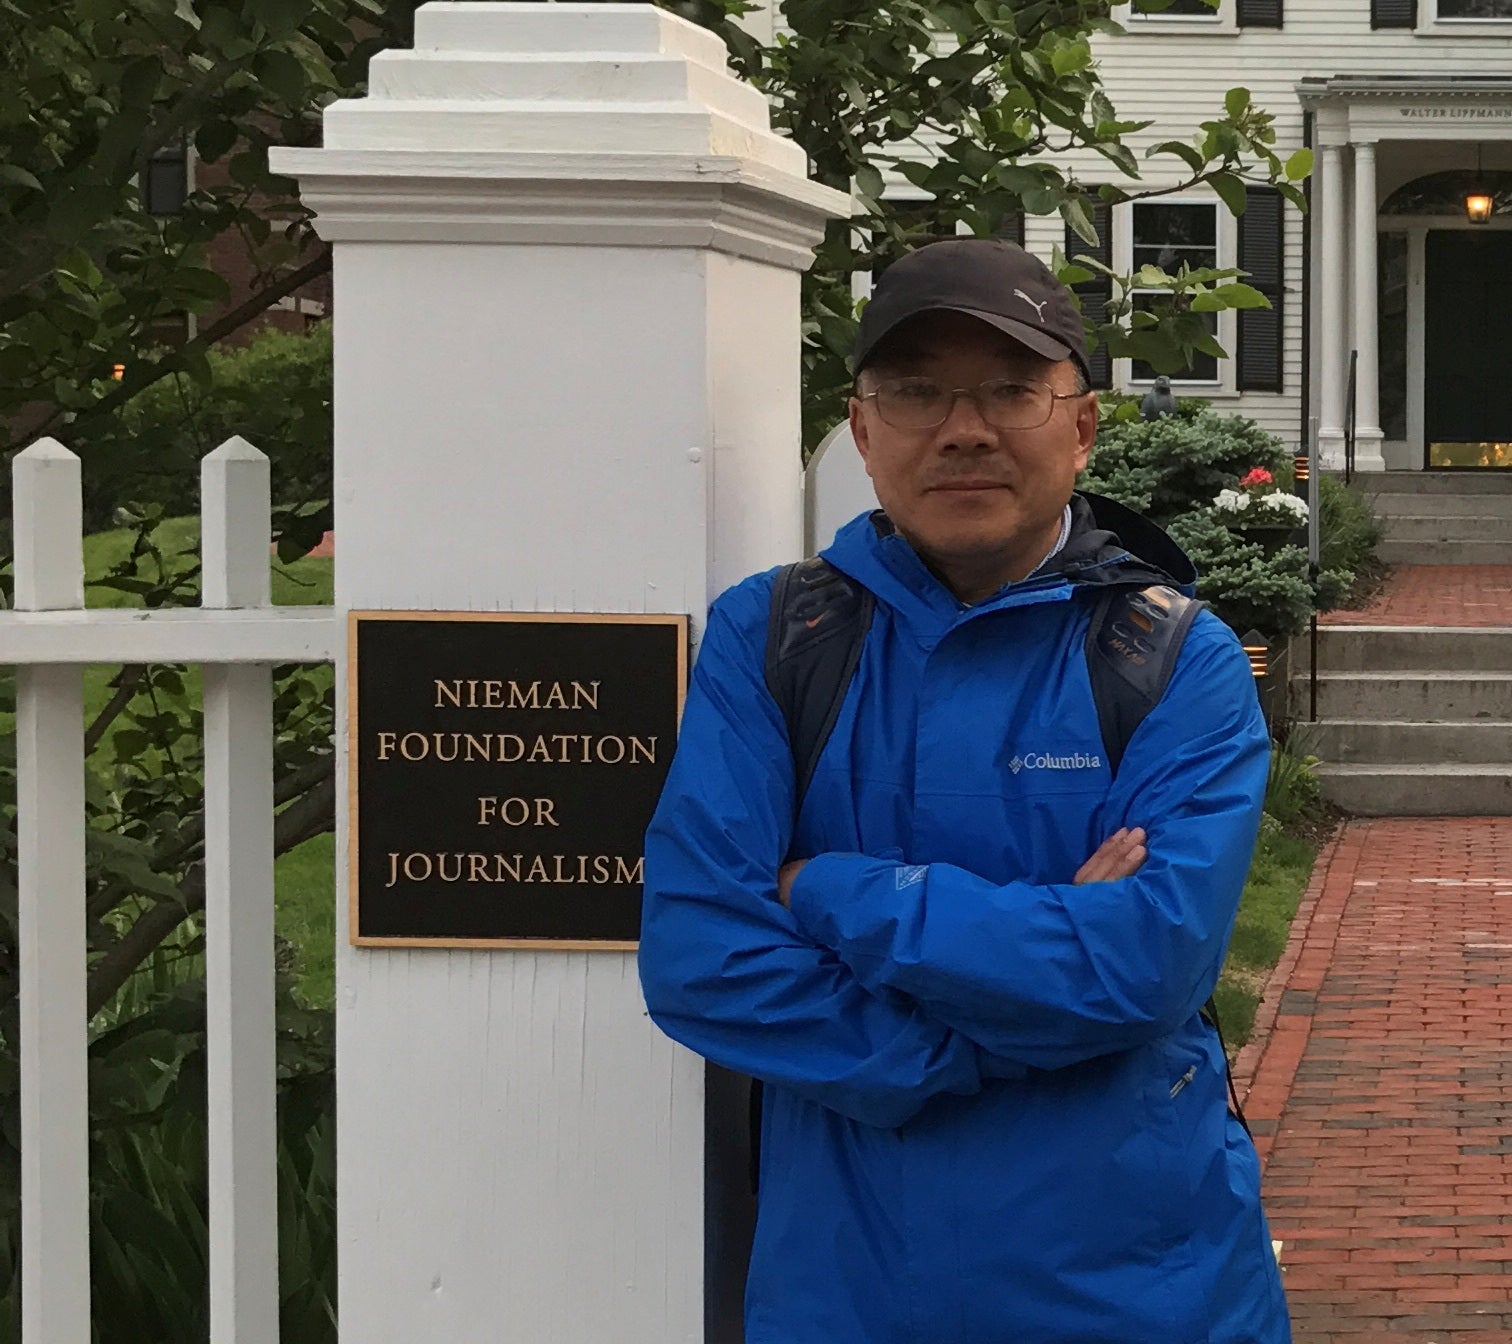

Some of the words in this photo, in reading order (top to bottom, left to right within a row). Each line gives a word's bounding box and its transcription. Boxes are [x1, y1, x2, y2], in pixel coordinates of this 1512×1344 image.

[1400, 108, 1446, 118] WALTER
[1450, 108, 1512, 118] LIPPMANN
[434, 679, 600, 709] NIEMAN
[377, 732, 658, 764] FOUNDATION
[1024, 752, 1101, 769] Columbia
[477, 796, 560, 826] FOR
[385, 852, 645, 887] JOURNALISM
